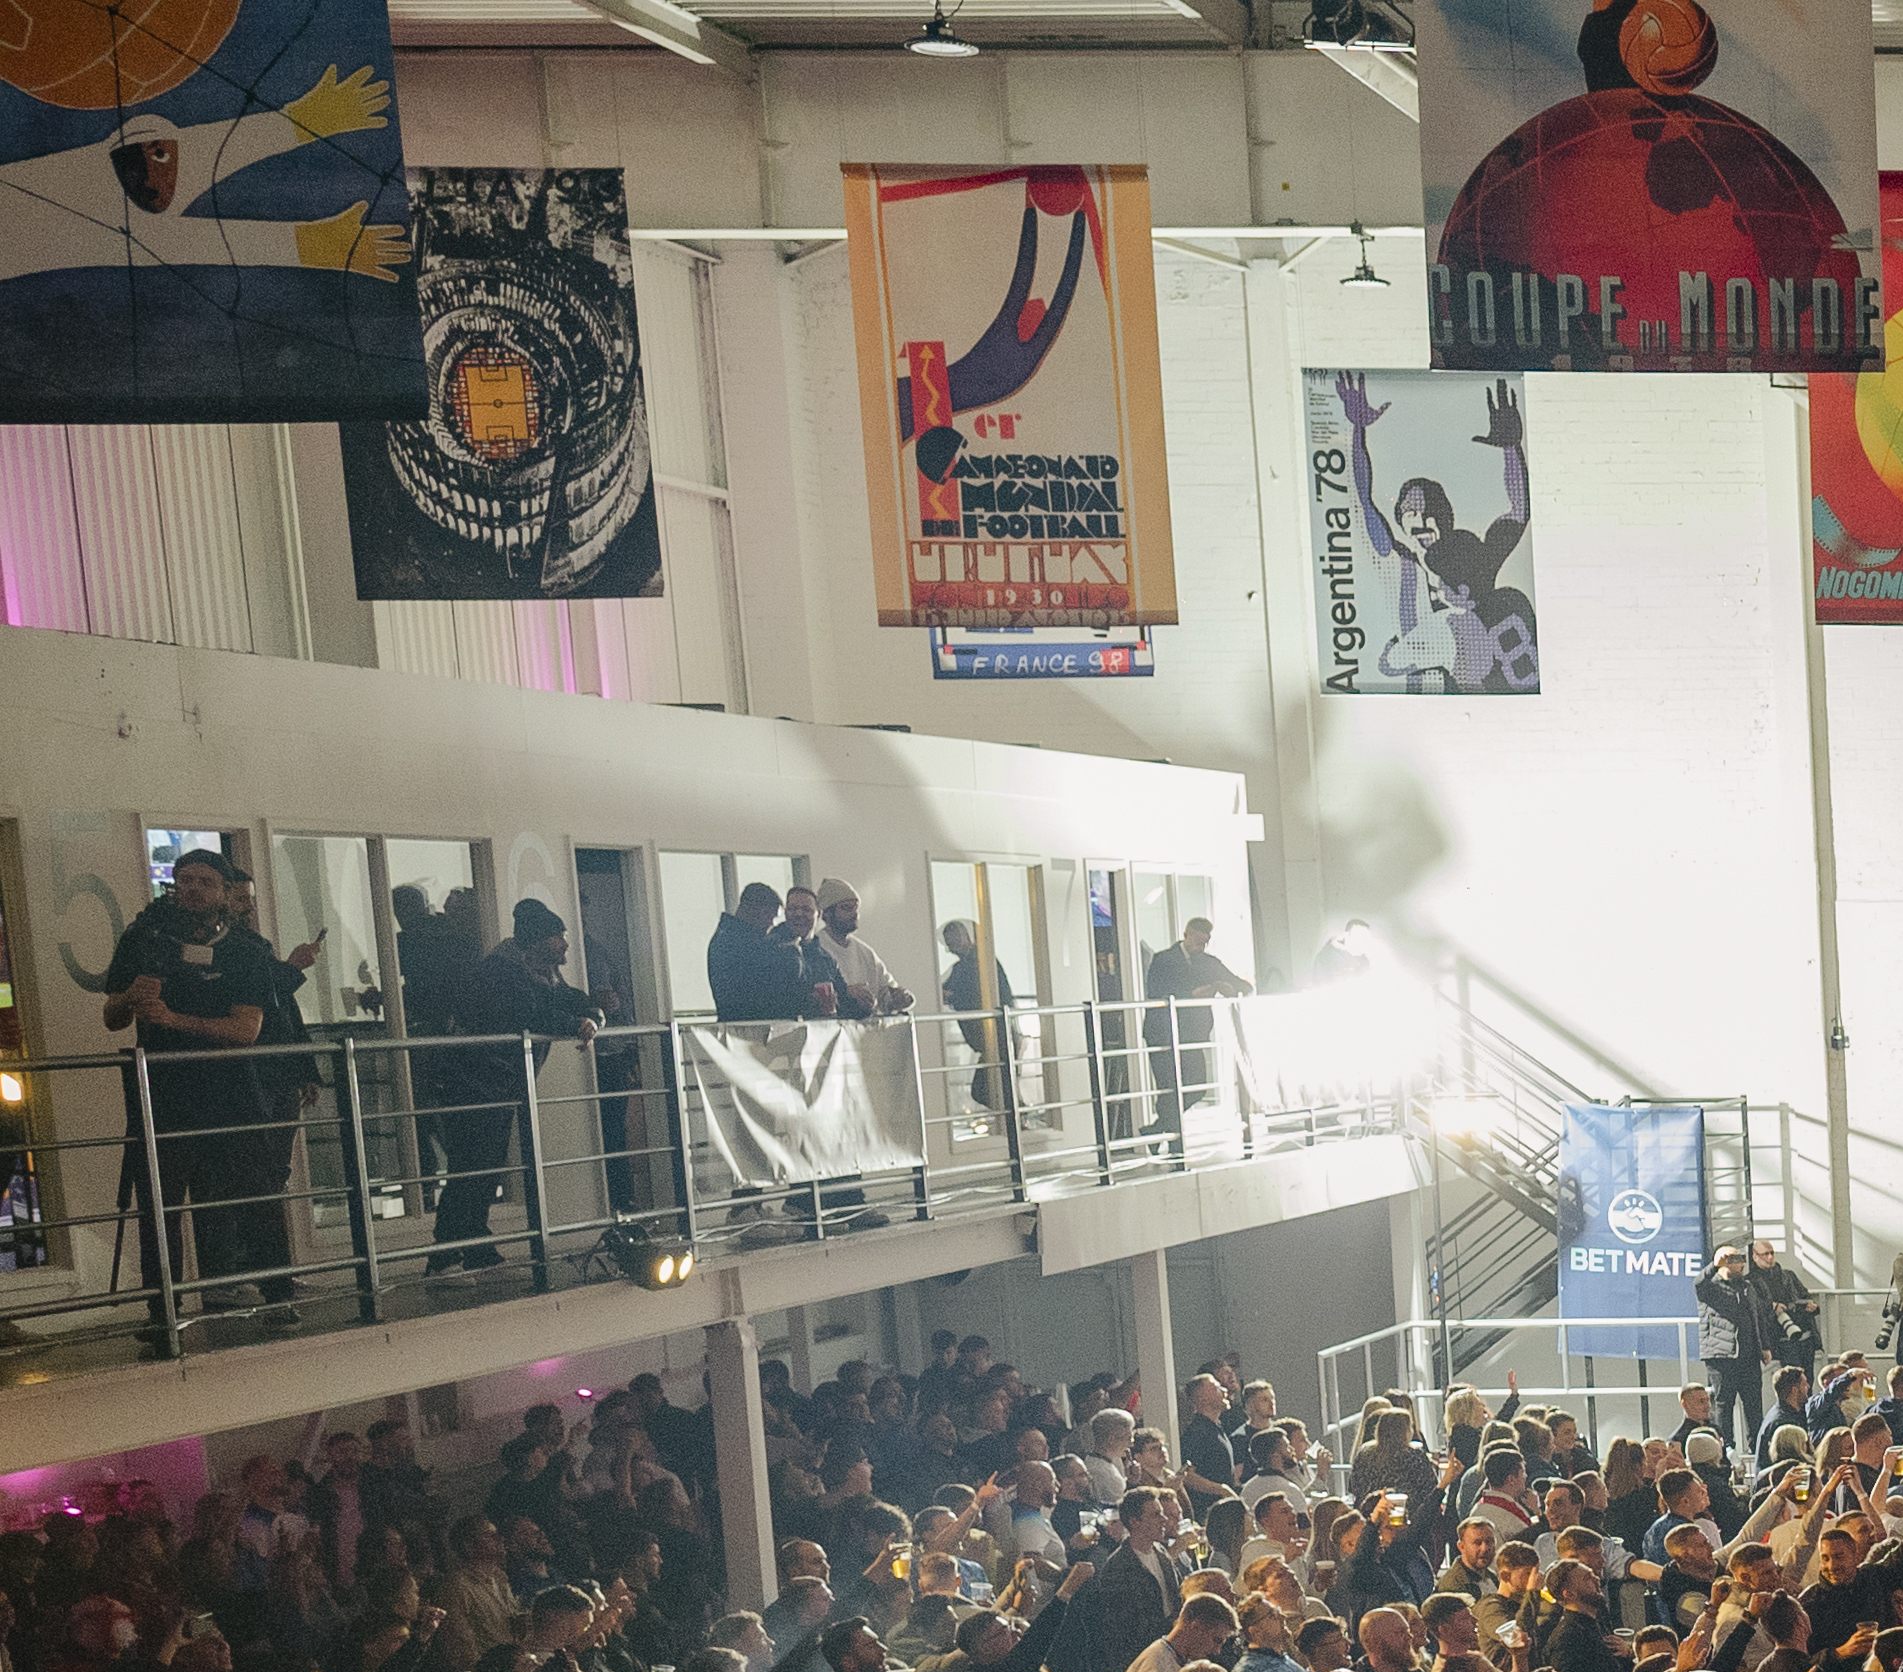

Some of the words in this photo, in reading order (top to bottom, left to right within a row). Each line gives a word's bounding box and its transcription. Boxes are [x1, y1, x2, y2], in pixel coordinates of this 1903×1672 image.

[1430, 264, 1624, 350] COUPE
[1678, 271, 1878, 358] MONDE
[1319, 508, 1366, 693] Argentina
[972, 654, 1077, 674] FRANCE
[1089, 651, 1124, 673] 98
